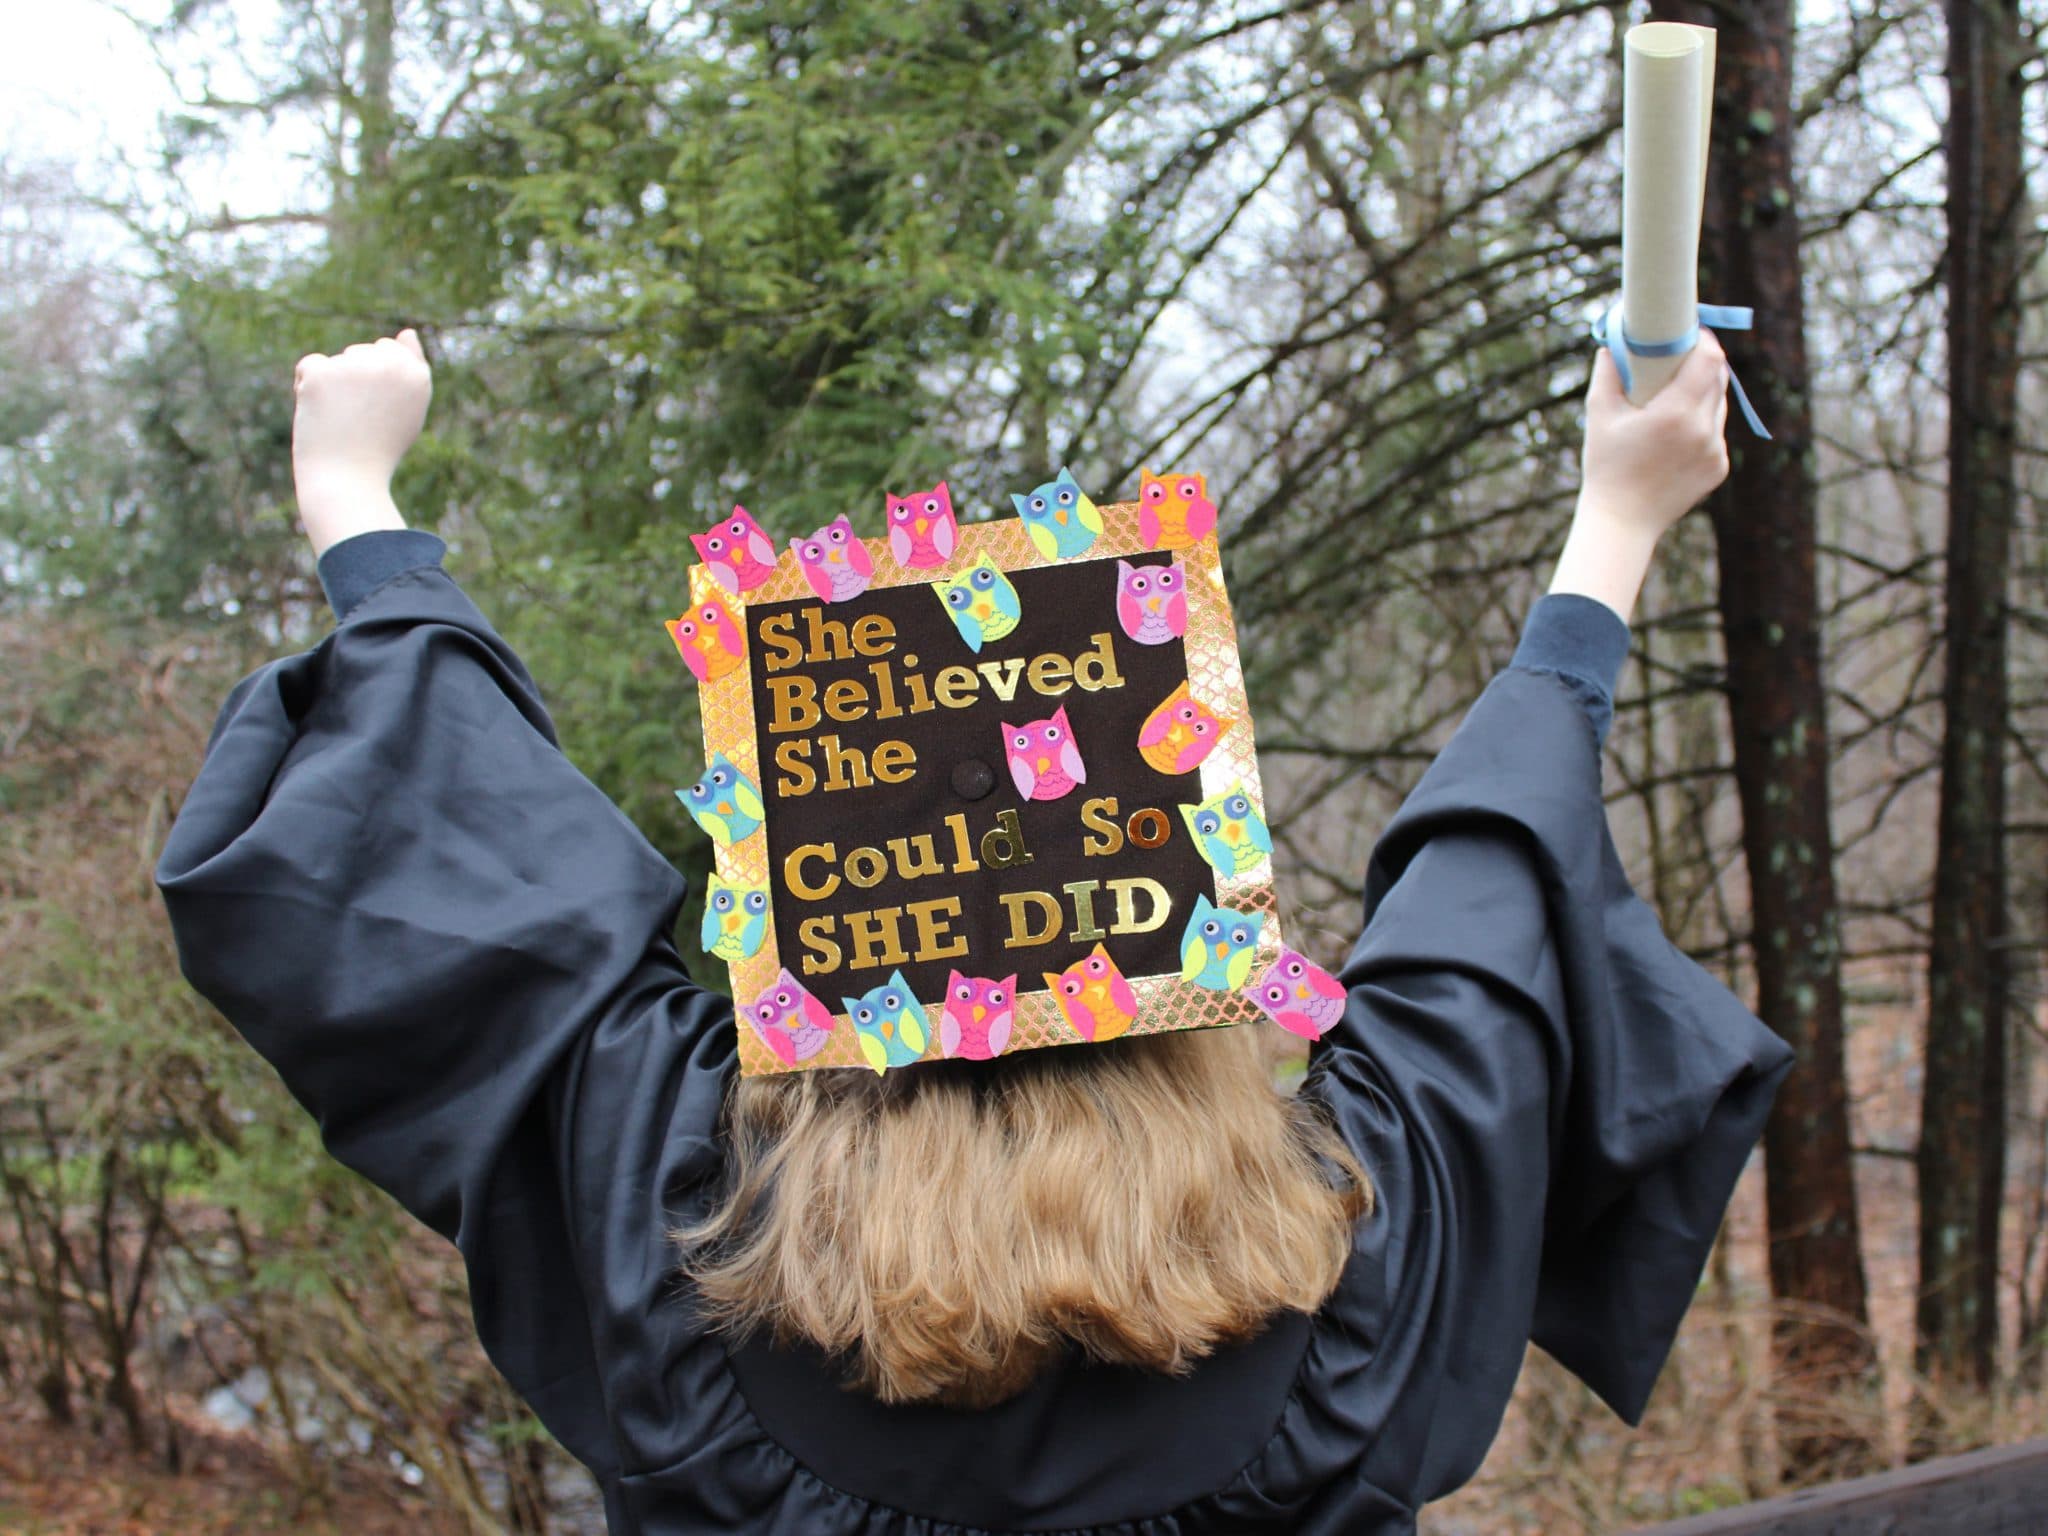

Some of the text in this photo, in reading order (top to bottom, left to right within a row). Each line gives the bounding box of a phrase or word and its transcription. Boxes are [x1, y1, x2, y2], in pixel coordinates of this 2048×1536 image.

[759, 607, 897, 671] She
[766, 632, 1124, 733] Believed
[775, 734, 917, 797] She
[784, 796, 1171, 900] Could So
[798, 877, 1172, 975] SHE DID
